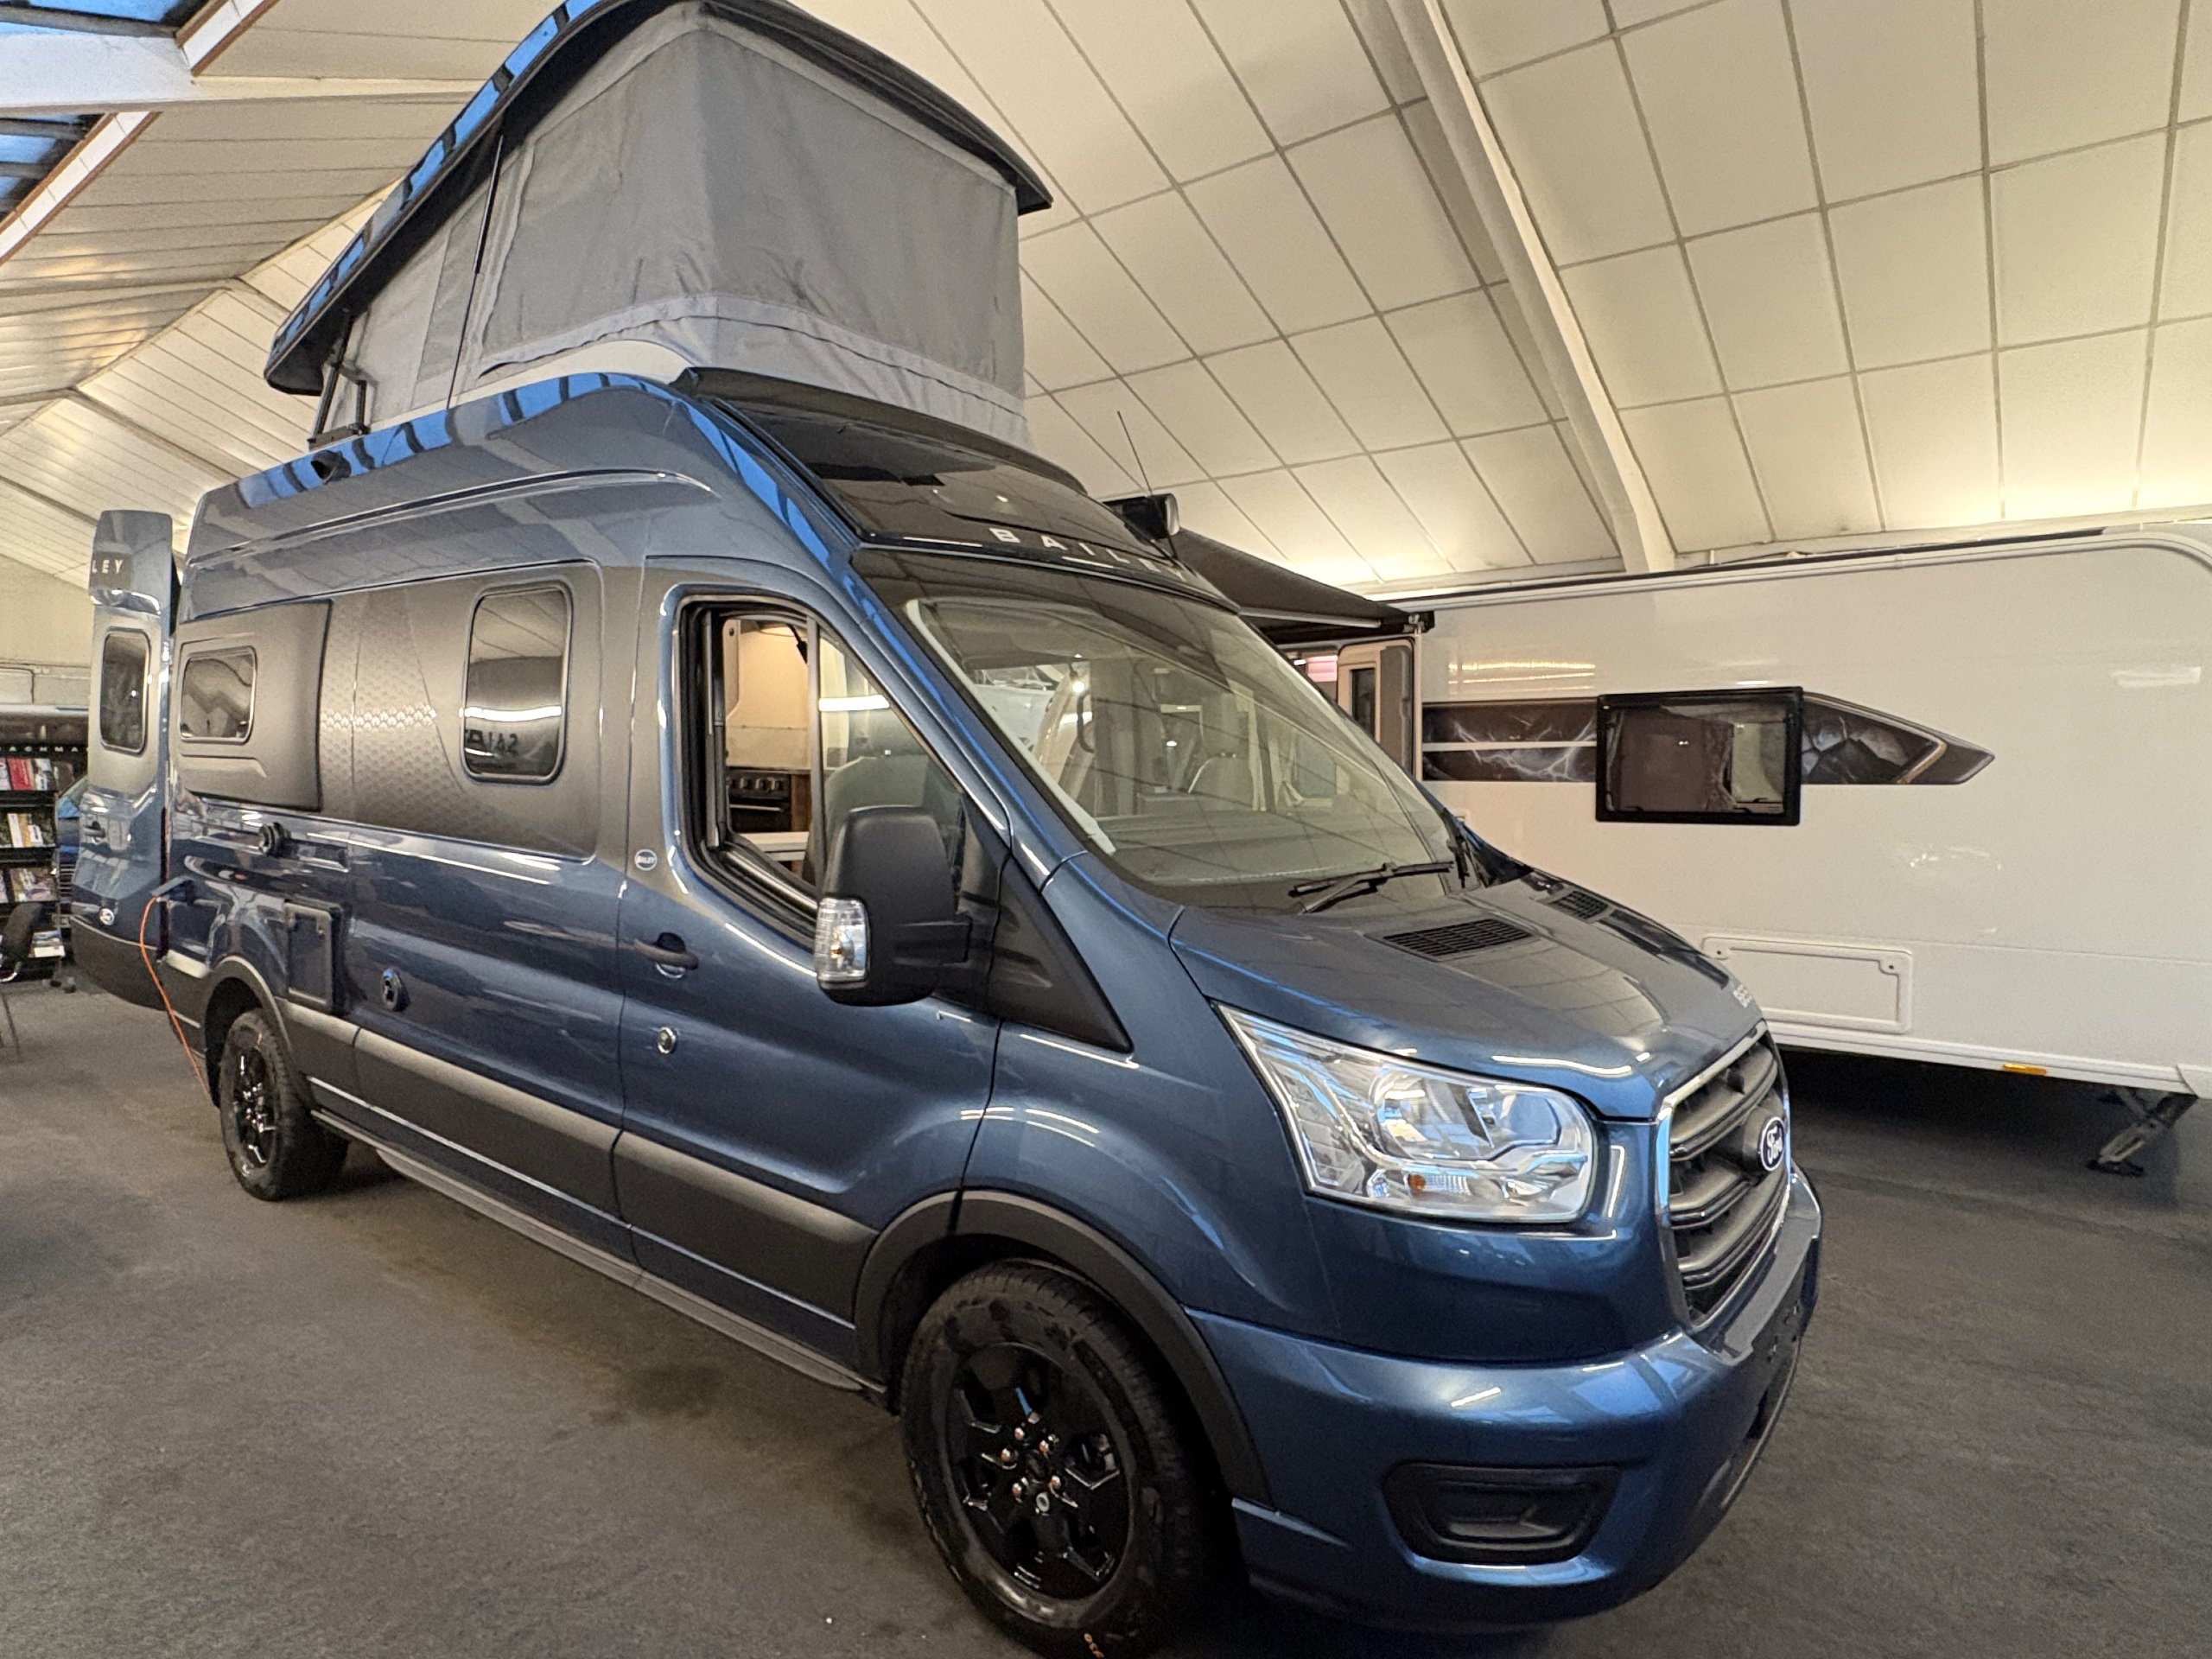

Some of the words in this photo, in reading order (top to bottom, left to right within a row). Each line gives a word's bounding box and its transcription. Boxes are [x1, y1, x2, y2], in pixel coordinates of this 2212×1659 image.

[92, 559, 124, 574] LEY
[988, 527, 1187, 582] BAILEY
[1765, 1124, 1783, 1165] Ford
